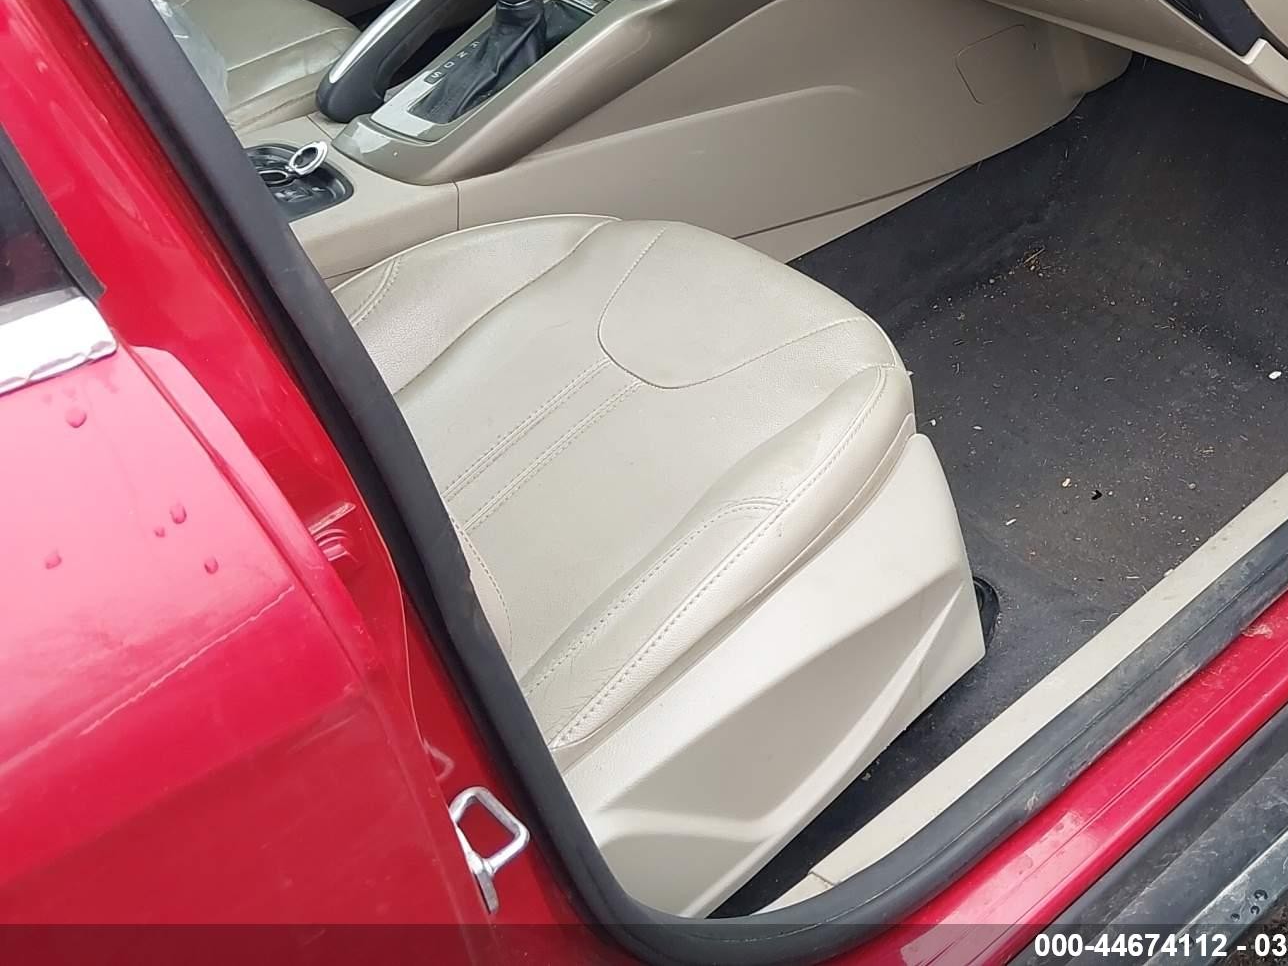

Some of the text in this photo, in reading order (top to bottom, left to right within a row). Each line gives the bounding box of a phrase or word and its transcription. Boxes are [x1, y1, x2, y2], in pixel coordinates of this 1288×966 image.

[456, 51, 468, 59] N
[443, 61, 455, 69] D
[431, 71, 442, 79] S
